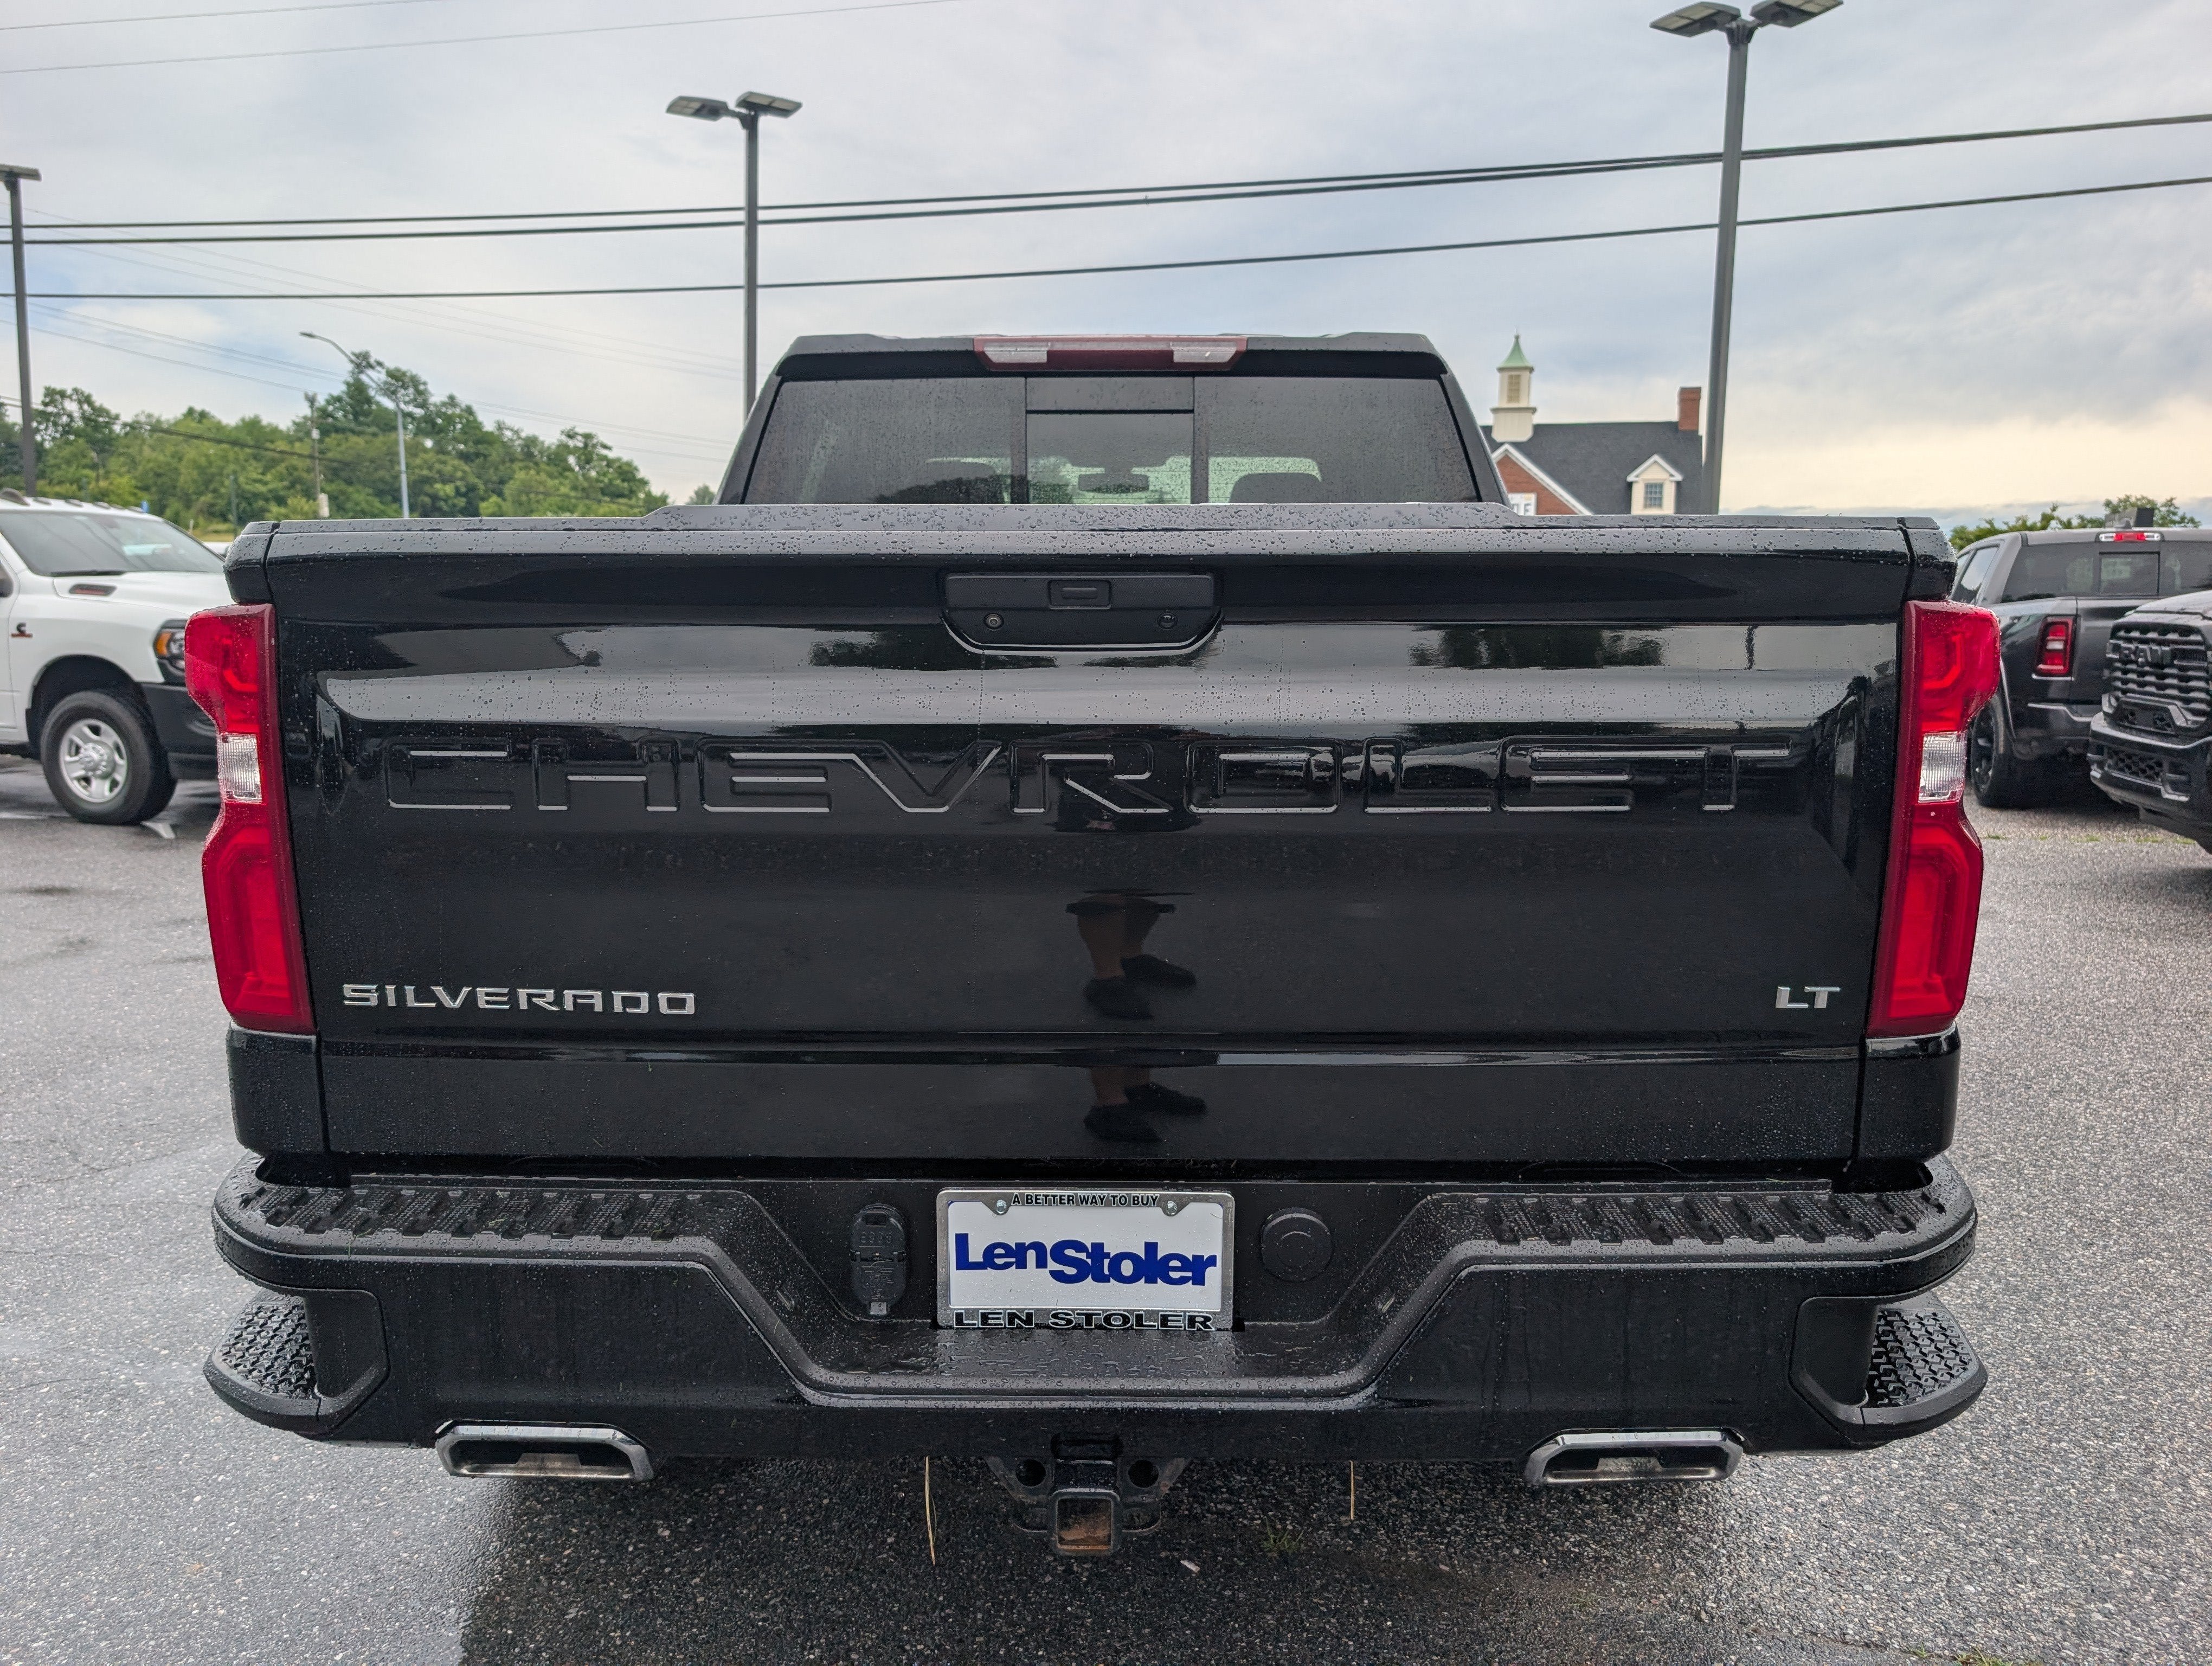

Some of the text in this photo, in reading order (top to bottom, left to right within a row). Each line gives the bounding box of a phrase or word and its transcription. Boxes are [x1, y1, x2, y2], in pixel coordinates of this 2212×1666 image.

[383, 736, 1792, 812] CHEVROLET
[343, 984, 697, 1015] SILVERADO
[1776, 986, 1840, 1008] LT
[1011, 1193, 1159, 1207] A BETTER WAY TO BUY
[954, 1310, 1215, 1331] LEN STOLER
